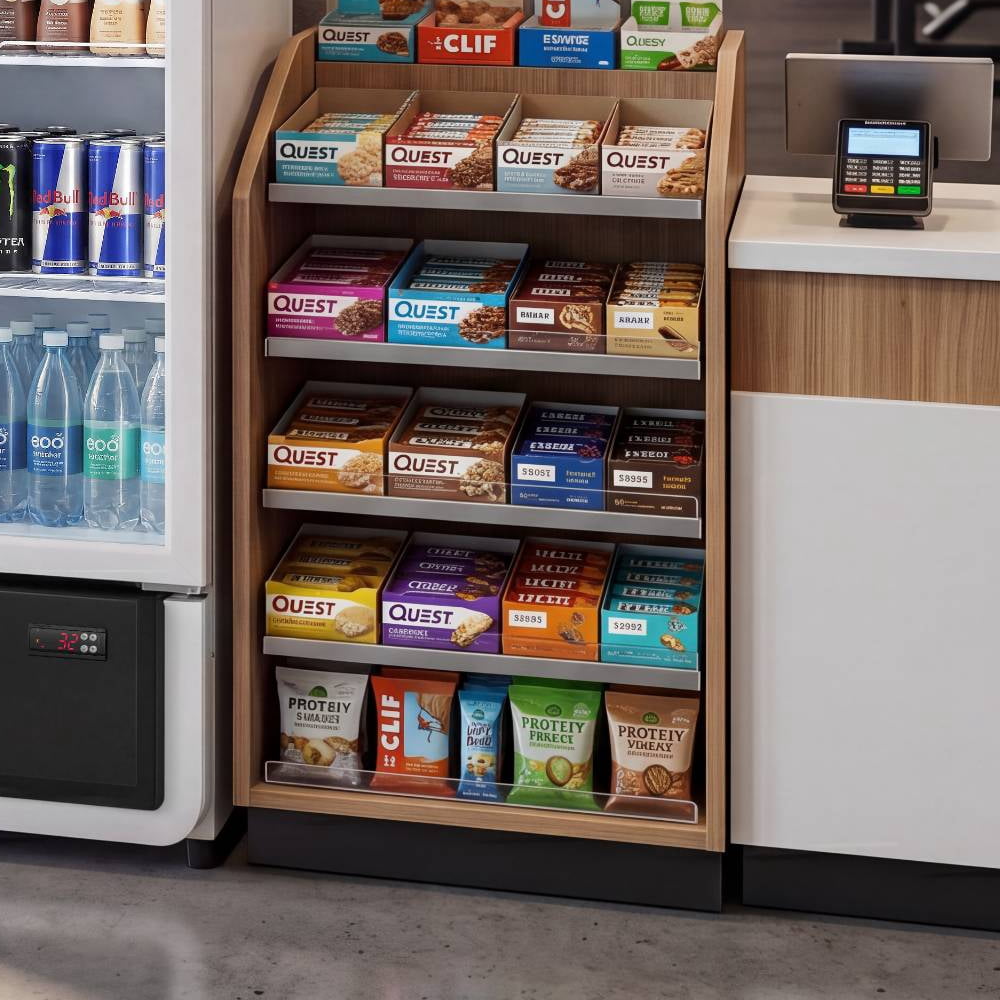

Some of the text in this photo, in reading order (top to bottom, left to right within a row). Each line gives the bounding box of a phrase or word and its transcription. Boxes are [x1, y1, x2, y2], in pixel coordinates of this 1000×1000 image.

[322, 28, 371, 43] QUEST
[443, 34, 497, 54] CLIF
[280, 142, 338, 160] QUEST
[391, 146, 453, 164] QUEST
[502, 148, 564, 166] QUEST
[606, 151, 671, 169] QUEST
[53, 190, 80, 204] Bull
[109, 192, 137, 206] Bull
[273, 294, 338, 314] QUEST
[394, 300, 460, 321] QUEST
[273, 445, 338, 467] QUEST
[393, 453, 459, 475] QUEST
[272, 594, 336, 616] QUEST
[388, 603, 454, 625] QUEST
[381, 694, 400, 751] CLIF
